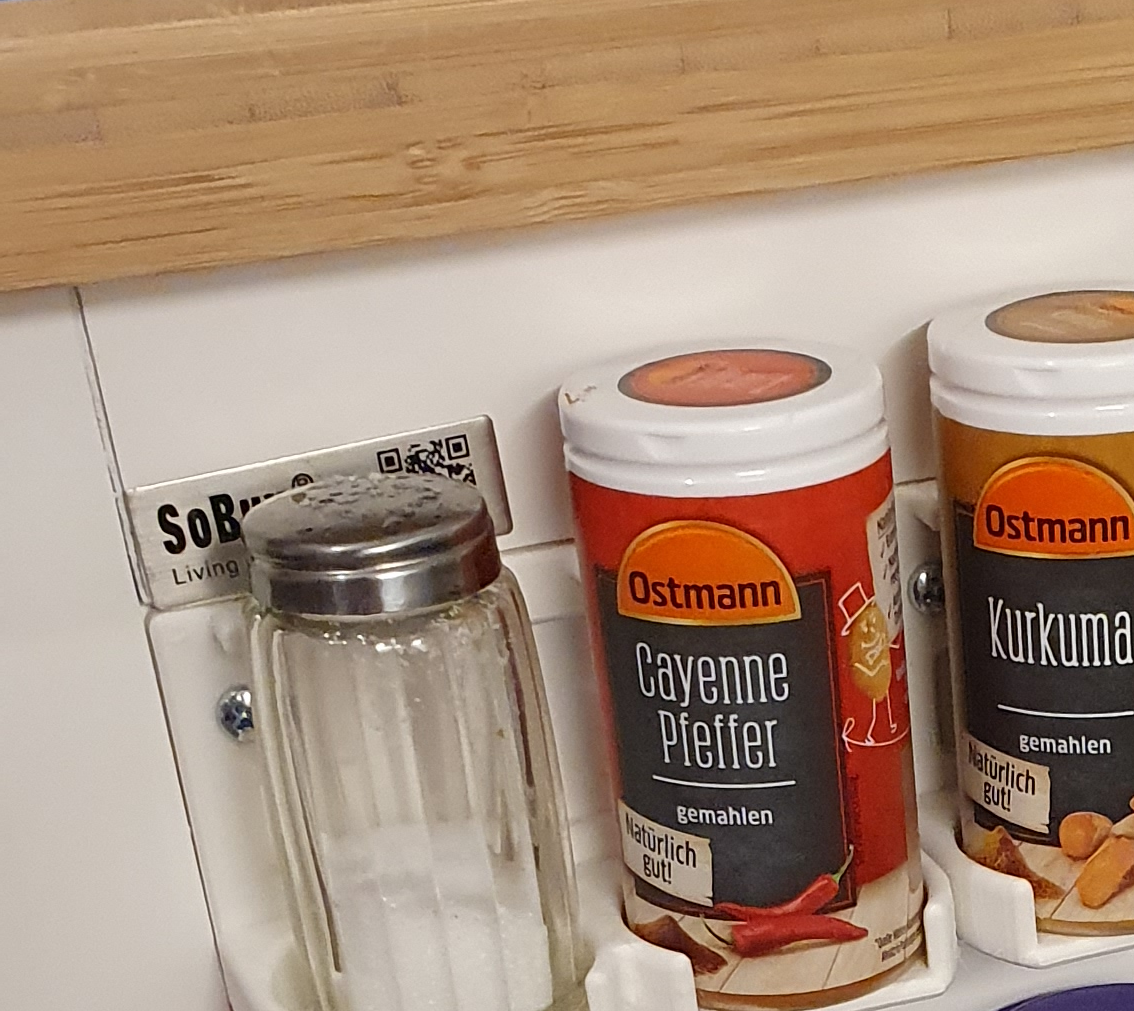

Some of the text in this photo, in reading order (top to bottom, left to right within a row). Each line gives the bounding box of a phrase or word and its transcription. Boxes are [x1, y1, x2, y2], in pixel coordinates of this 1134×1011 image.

[985, 504, 1130, 544] Ostmann
[172, 559, 240, 586] Living
[628, 570, 782, 610] Ostmann
[988, 596, 1134, 668] Kurkuma
[635, 641, 790, 708] Cayenne
[657, 710, 778, 769] Pfeffer
[1019, 734, 1111, 755] gemahlen
[968, 741, 1036, 795] Natürlich
[676, 804, 774, 827] gemahlen
[984, 782, 1012, 812] gut!
[625, 812, 697, 868] Natürlich
[642, 853, 672, 884] gut!
